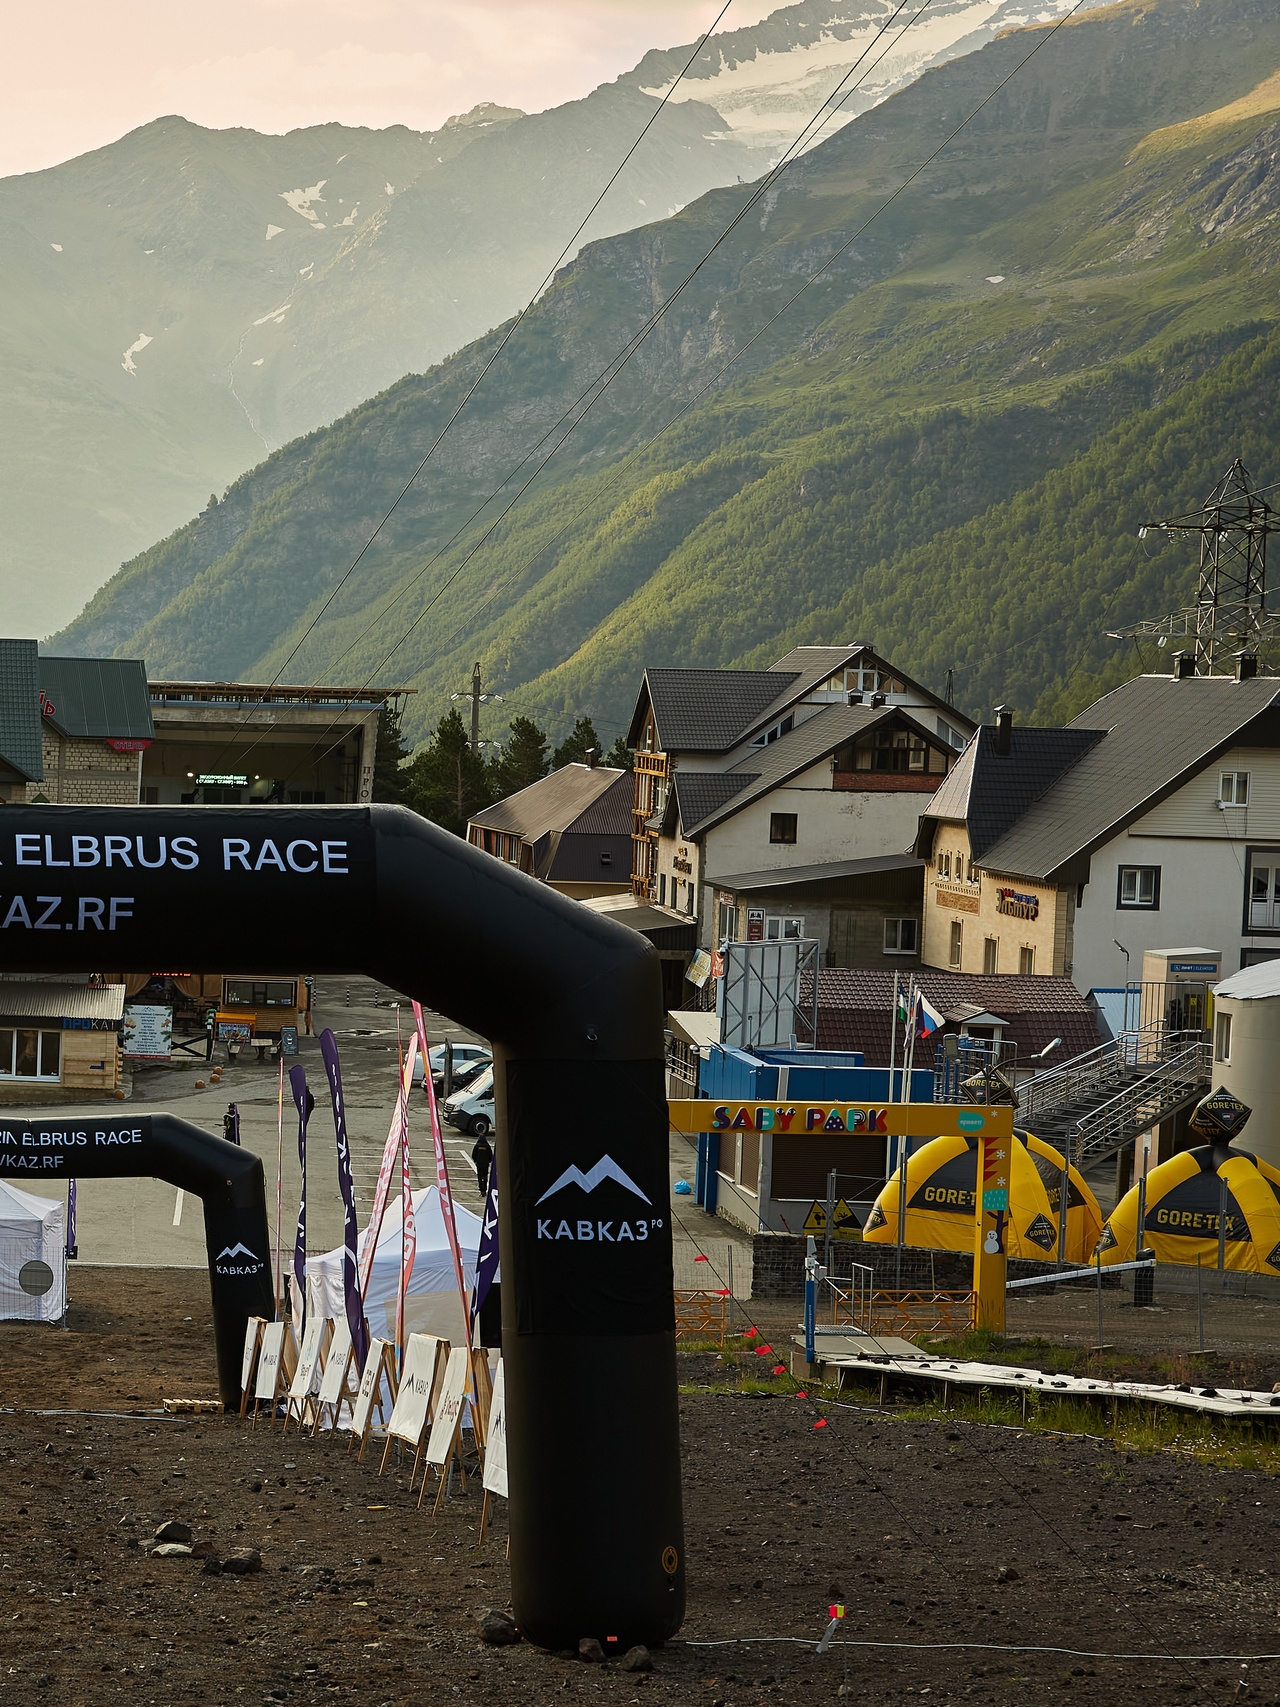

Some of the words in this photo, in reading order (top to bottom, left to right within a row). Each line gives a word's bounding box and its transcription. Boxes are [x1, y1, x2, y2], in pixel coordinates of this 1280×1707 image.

[114, 741, 145, 750] ОТЕЛЬ
[15, 834, 199, 869] ELBRUS
[222, 837, 349, 874] RACE
[63, 1018, 116, 1030] ПРОКАТ
[1206, 1101, 1245, 1111] GORE-TEX
[712, 1105, 796, 1132] SABY
[805, 1107, 888, 1133] PARK
[22, 1132, 87, 1147] ELBRUS
[95, 1129, 142, 1146] RACE
[536, 1219, 649, 1242] КАВКАЗ
[216, 1265, 258, 1275] КАВКАЗ
